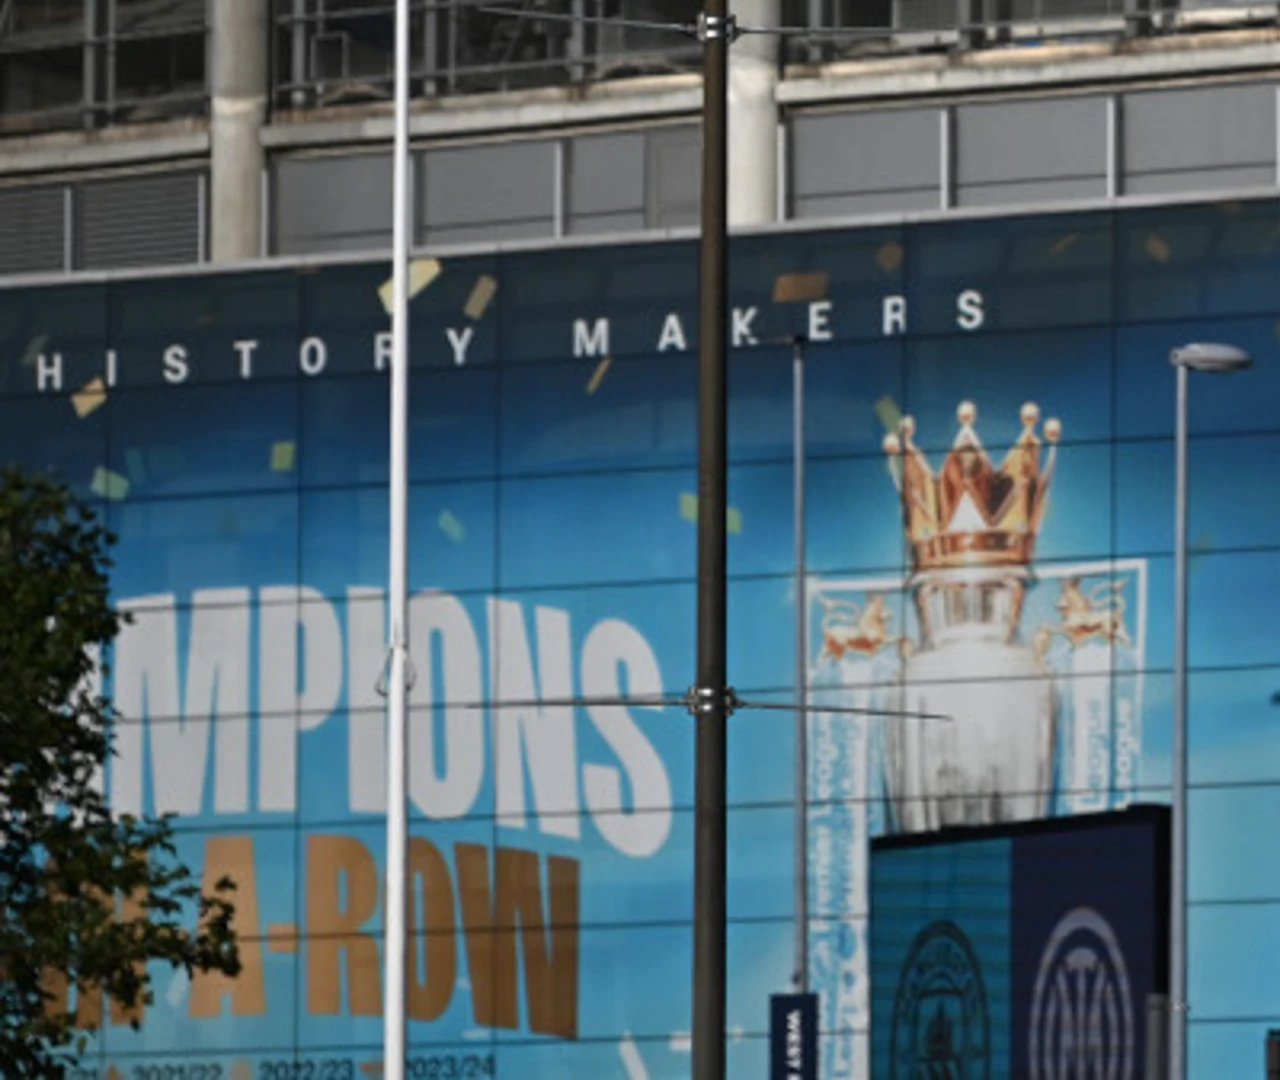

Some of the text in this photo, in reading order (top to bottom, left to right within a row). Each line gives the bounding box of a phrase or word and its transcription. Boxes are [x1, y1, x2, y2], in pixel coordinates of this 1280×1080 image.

[37, 291, 983, 390] HISTORY MAKERS
[84, 584, 673, 858] MPIONS
